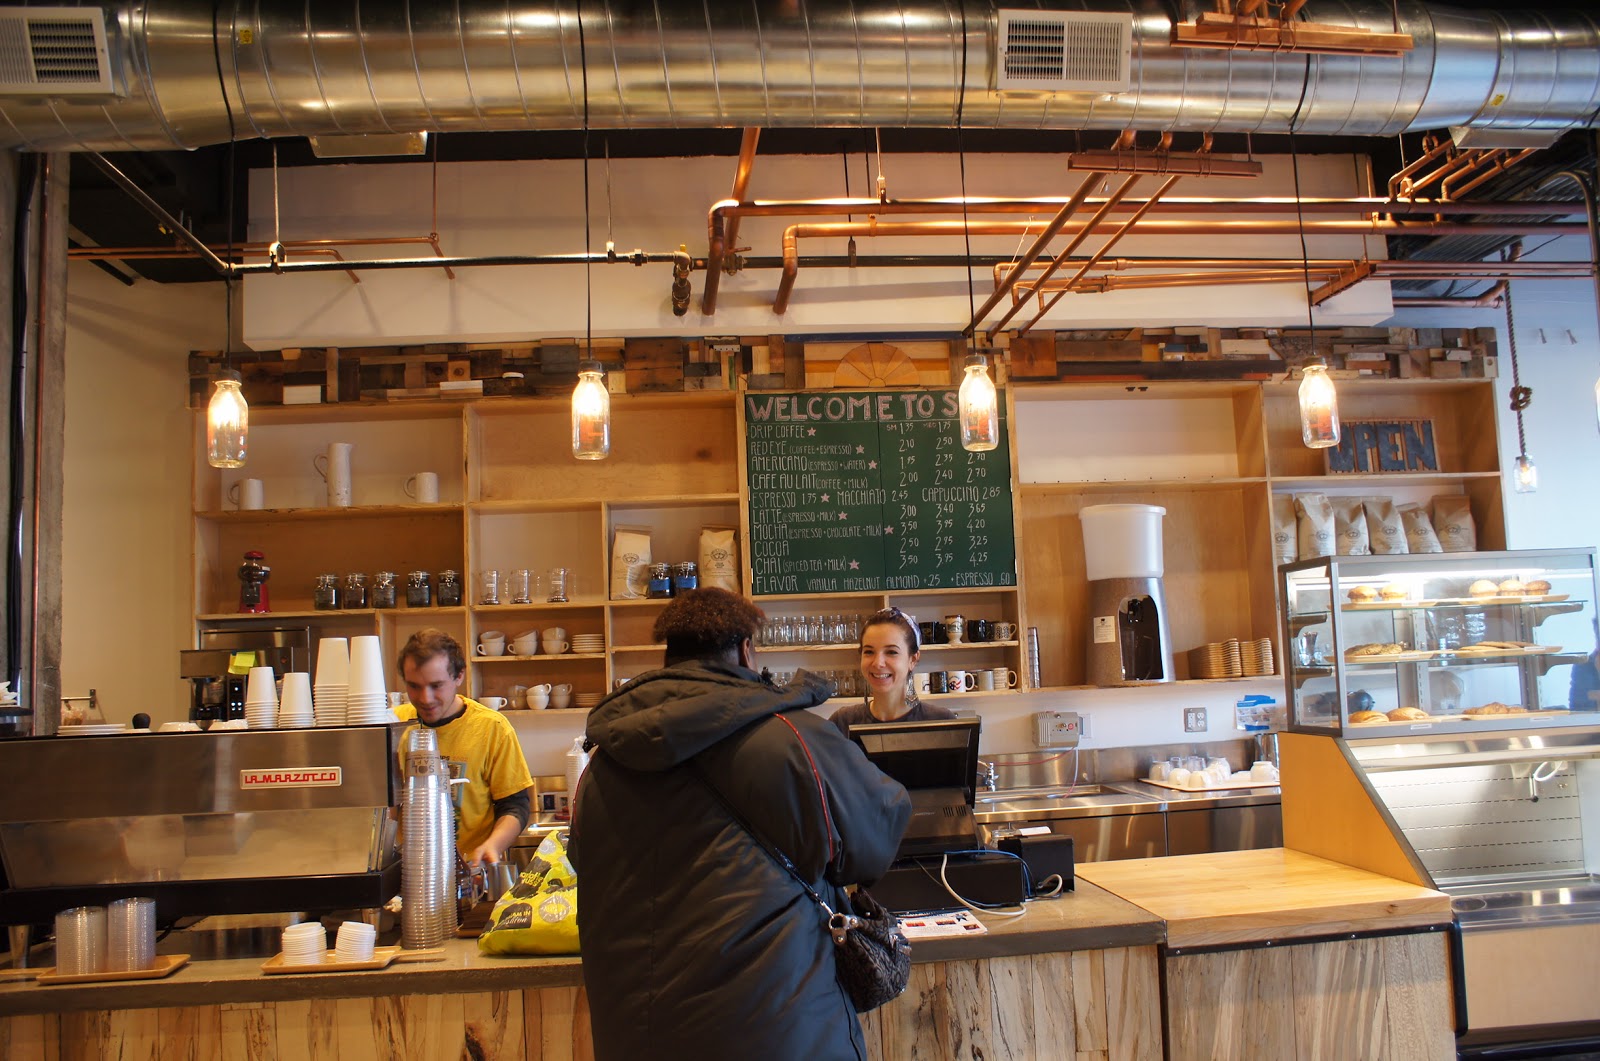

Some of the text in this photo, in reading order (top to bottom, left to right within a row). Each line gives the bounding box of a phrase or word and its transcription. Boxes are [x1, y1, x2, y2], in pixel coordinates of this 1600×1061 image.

[748, 396, 893, 421] WELCOME
[900, 394, 935, 419] TO
[750, 425, 773, 439] DRIP
[775, 425, 805, 439] COFFEE
[750, 441, 768, 455] RED
[770, 441, 787, 455] EYE
[752, 456, 807, 471] AMERICANO
[752, 473, 777, 490] CAFE
[779, 473, 793, 489] AU
[795, 473, 816, 489] LAIT
[752, 491, 796, 508] ESPRESSO
[837, 488, 886, 506] MACCHIATO
[922, 486, 979, 502] CAPPUCCINO
[752, 509, 782, 524] LATTE
[753, 523, 787, 540] MOCHA
[754, 540, 789, 557] COCOA
[755, 557, 781, 575] CHAI
[810, 559, 823, 571] TEA
[756, 575, 799, 593] FLAVOR
[806, 577, 837, 591] VANILLA
[843, 576, 880, 590] HAZELNUT
[886, 574, 920, 589] ALMOND
[245, 775, 256, 783] LA
